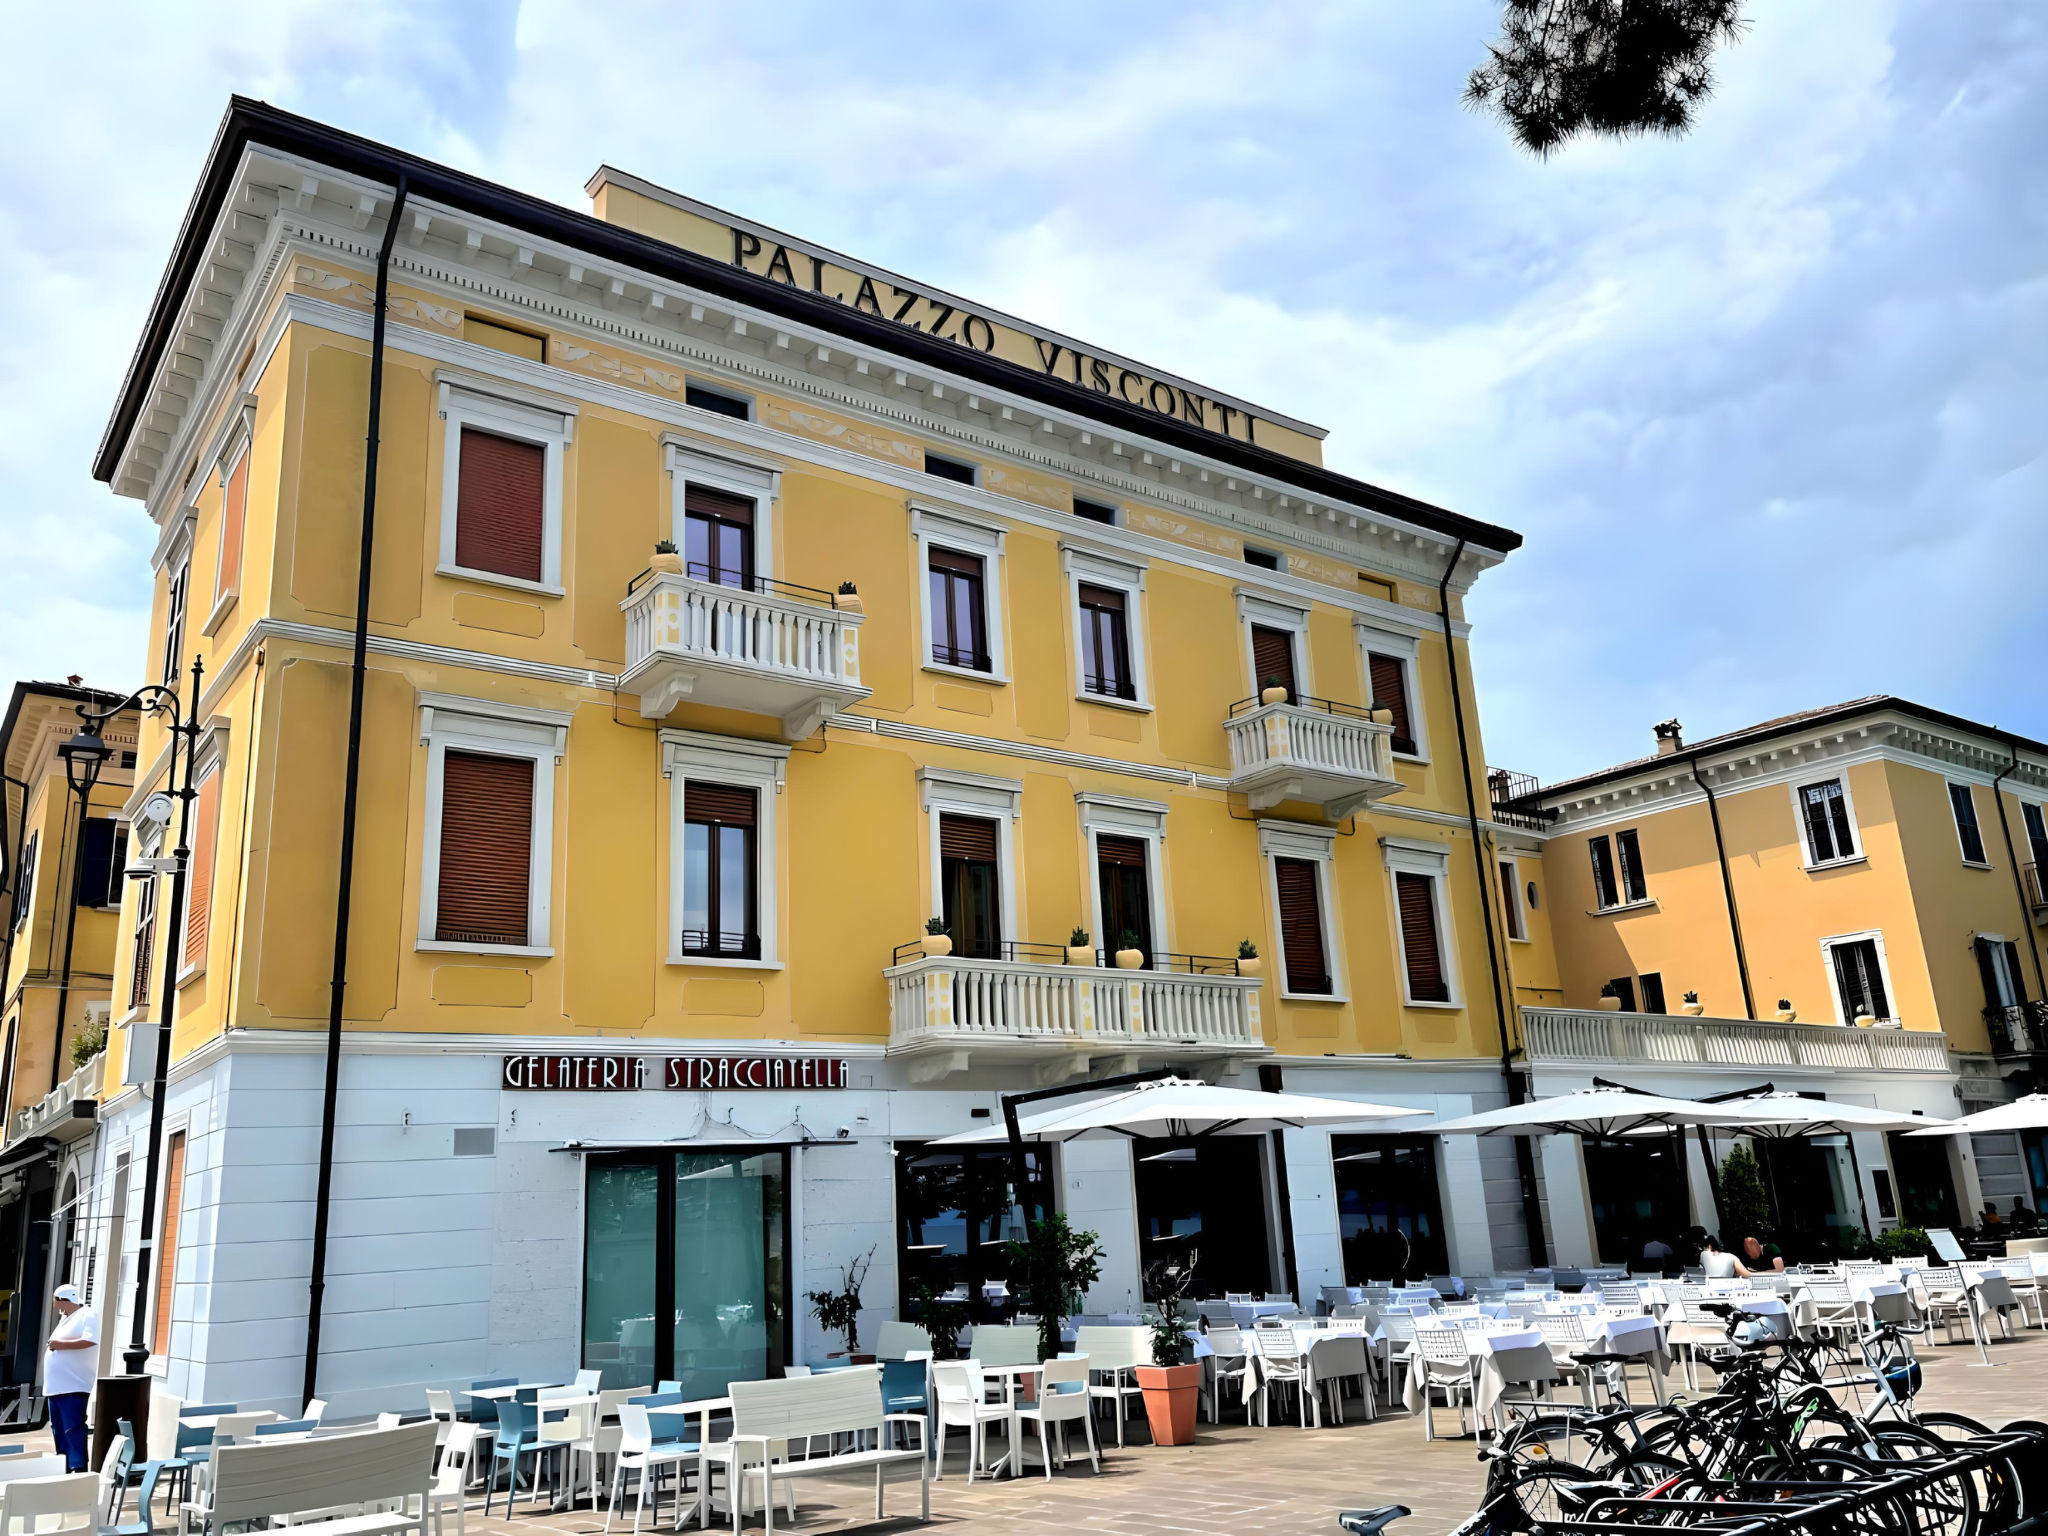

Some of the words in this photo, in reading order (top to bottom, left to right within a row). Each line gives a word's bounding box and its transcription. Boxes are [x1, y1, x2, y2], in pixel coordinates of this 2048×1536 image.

[731, 227, 995, 353] PALAZZO
[1032, 337, 1256, 444] VISCONTI
[505, 1056, 645, 1088] GELATERIA
[668, 1058, 849, 1088] STRACCIATELLA
